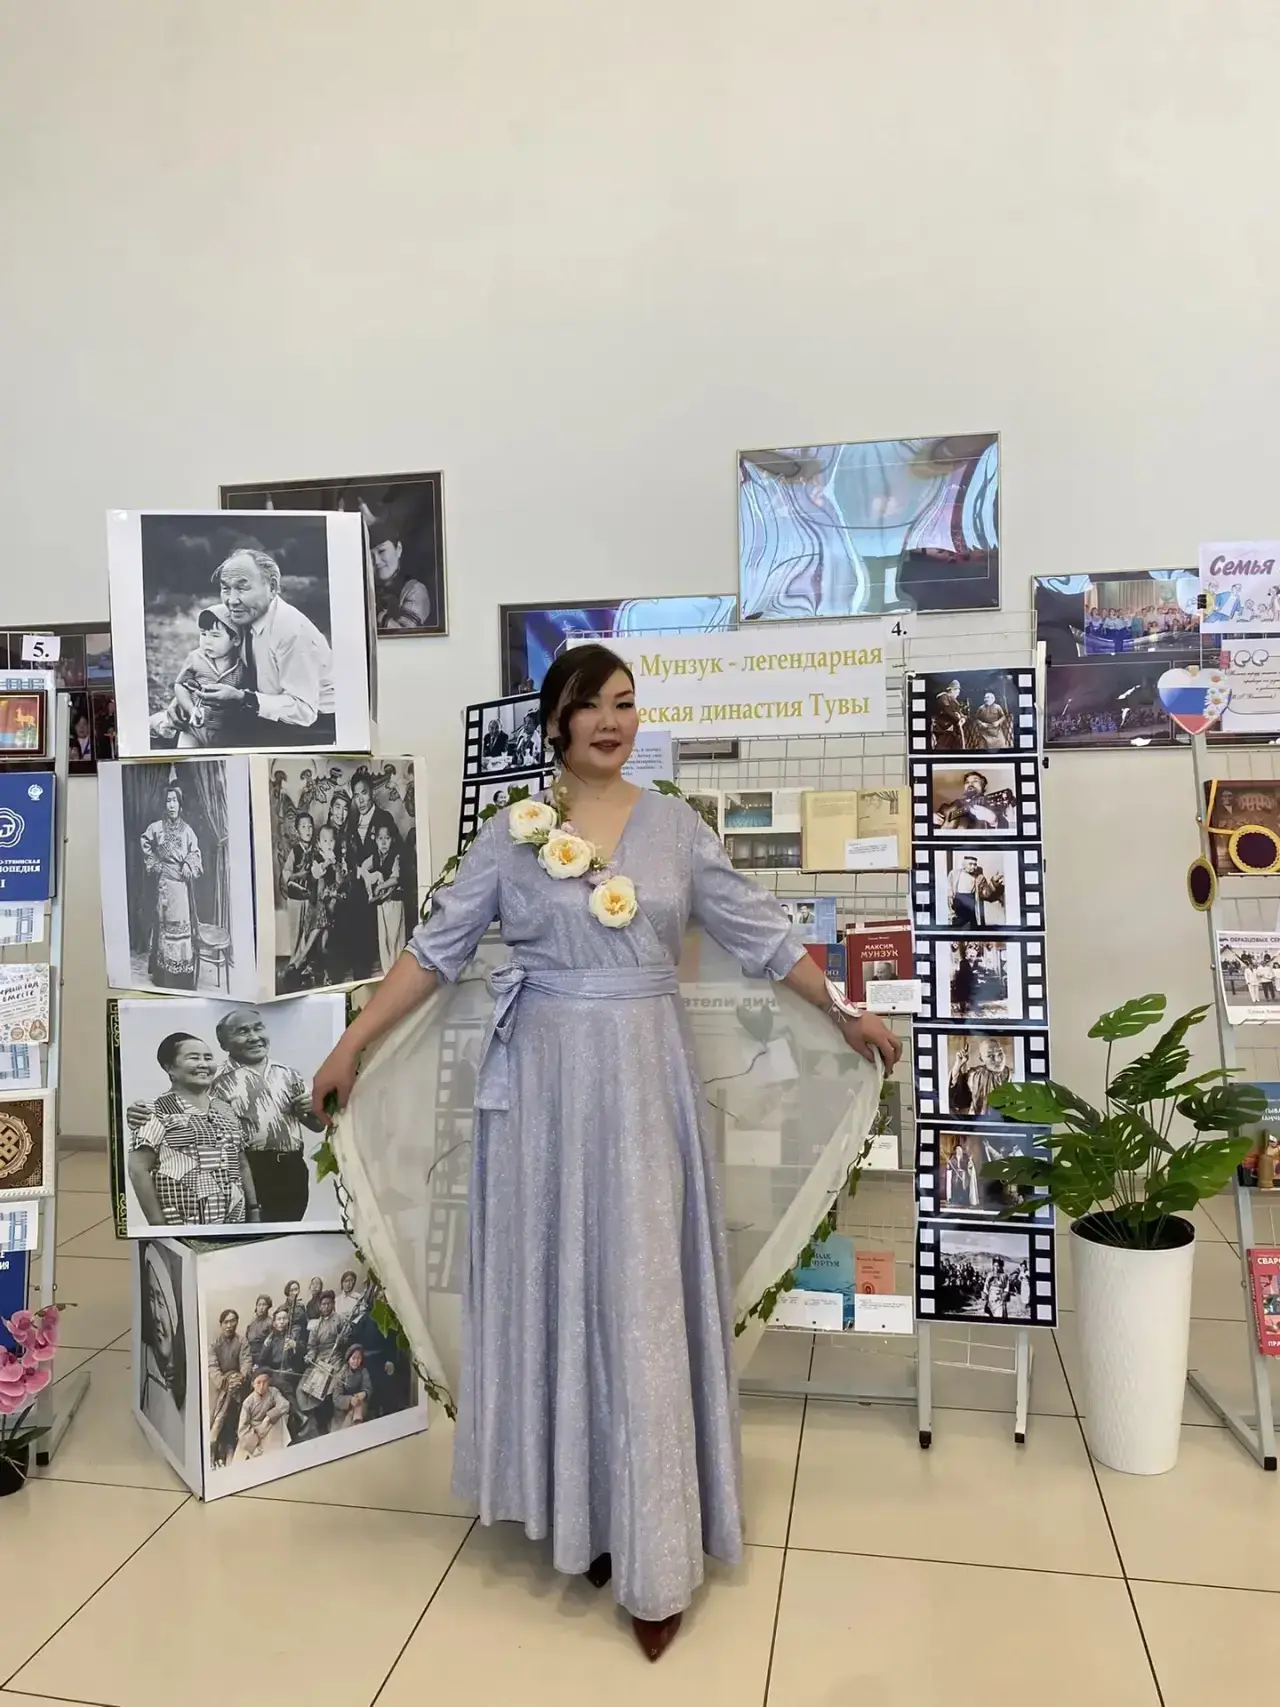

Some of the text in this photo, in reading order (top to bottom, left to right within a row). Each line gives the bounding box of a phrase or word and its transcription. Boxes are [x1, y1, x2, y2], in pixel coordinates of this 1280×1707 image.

[1210, 555, 1275, 576] Семья
[891, 621, 907, 636] 4.
[33, 642, 49, 657] 5.
[640, 654, 723, 683] Мунзук
[742, 647, 882, 674] легендарная
[699, 700, 803, 724] династия
[809, 693, 870, 723] Тувы
[861, 950, 899, 958] МУНЗУК
[1258, 1257, 1280, 1265] СВАР
